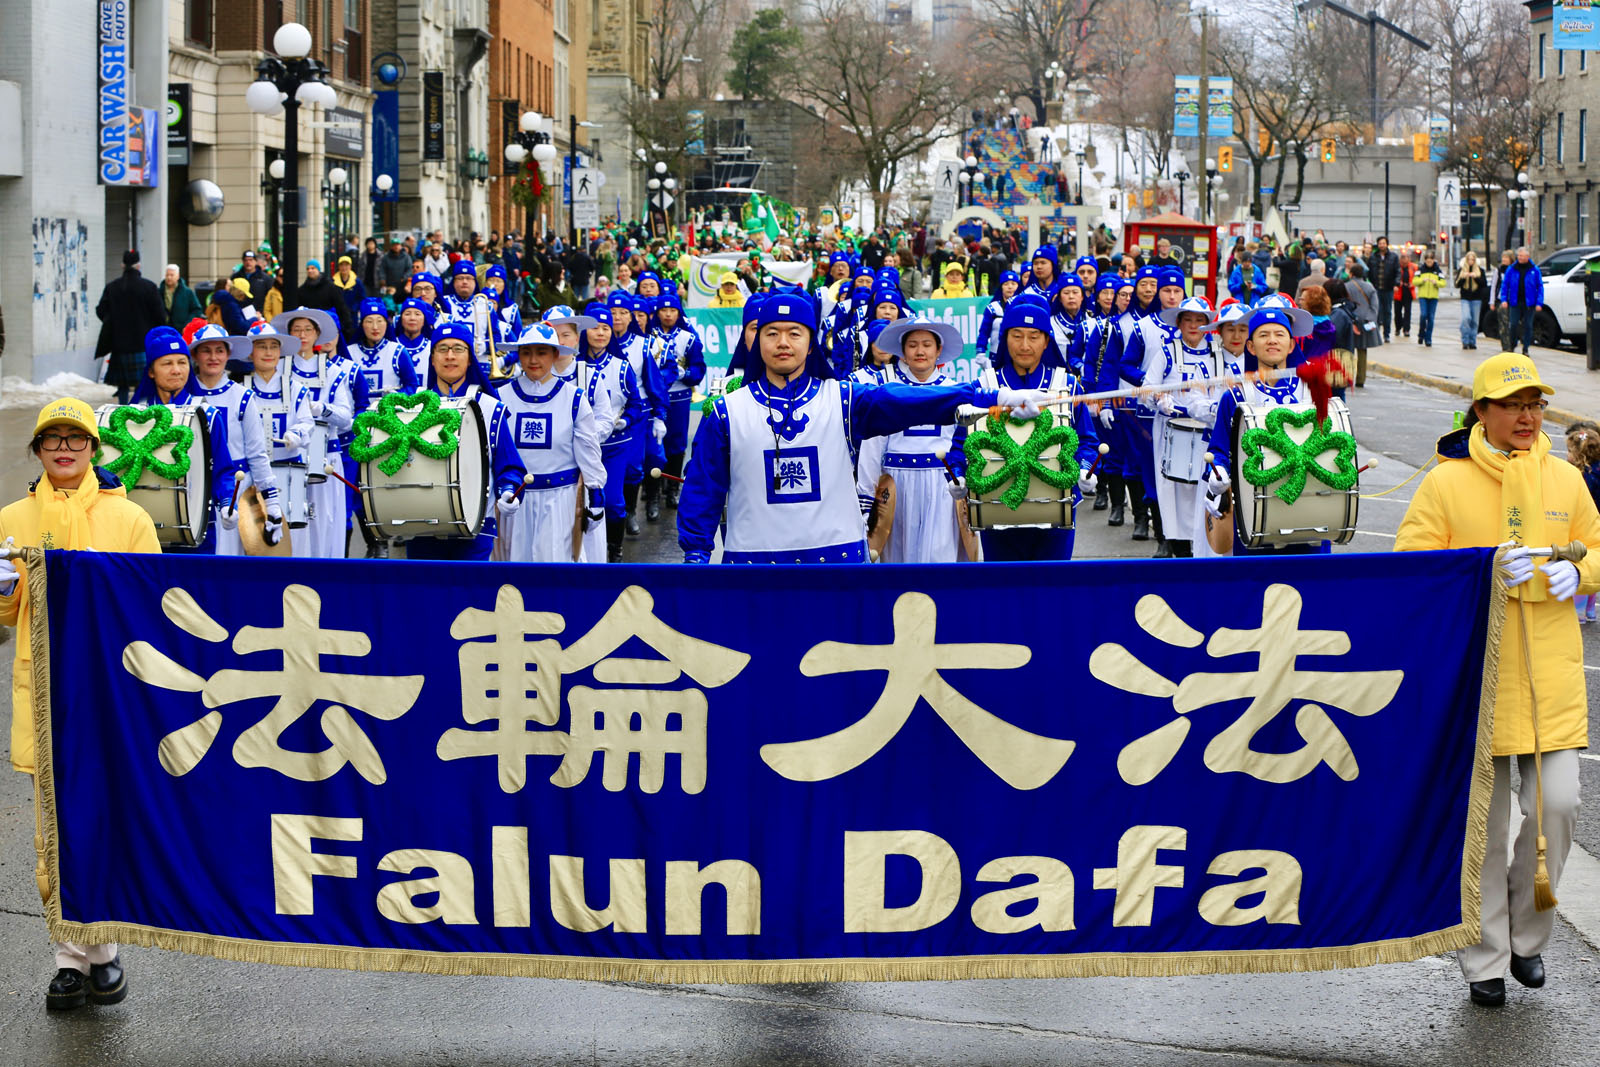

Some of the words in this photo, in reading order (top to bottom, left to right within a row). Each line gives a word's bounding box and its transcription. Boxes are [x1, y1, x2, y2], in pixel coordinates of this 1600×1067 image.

[103, 2, 112, 40] LAVE
[115, 1, 125, 40] AUTO
[103, 44, 126, 122] WASH
[103, 124, 126, 182] CAR
[523, 421, 544, 440] 樂
[779, 461, 808, 489] 樂
[122, 583, 1405, 795] 法輪大法
[270, 814, 762, 936] Falun
[844, 825, 1302, 934] Dafa
